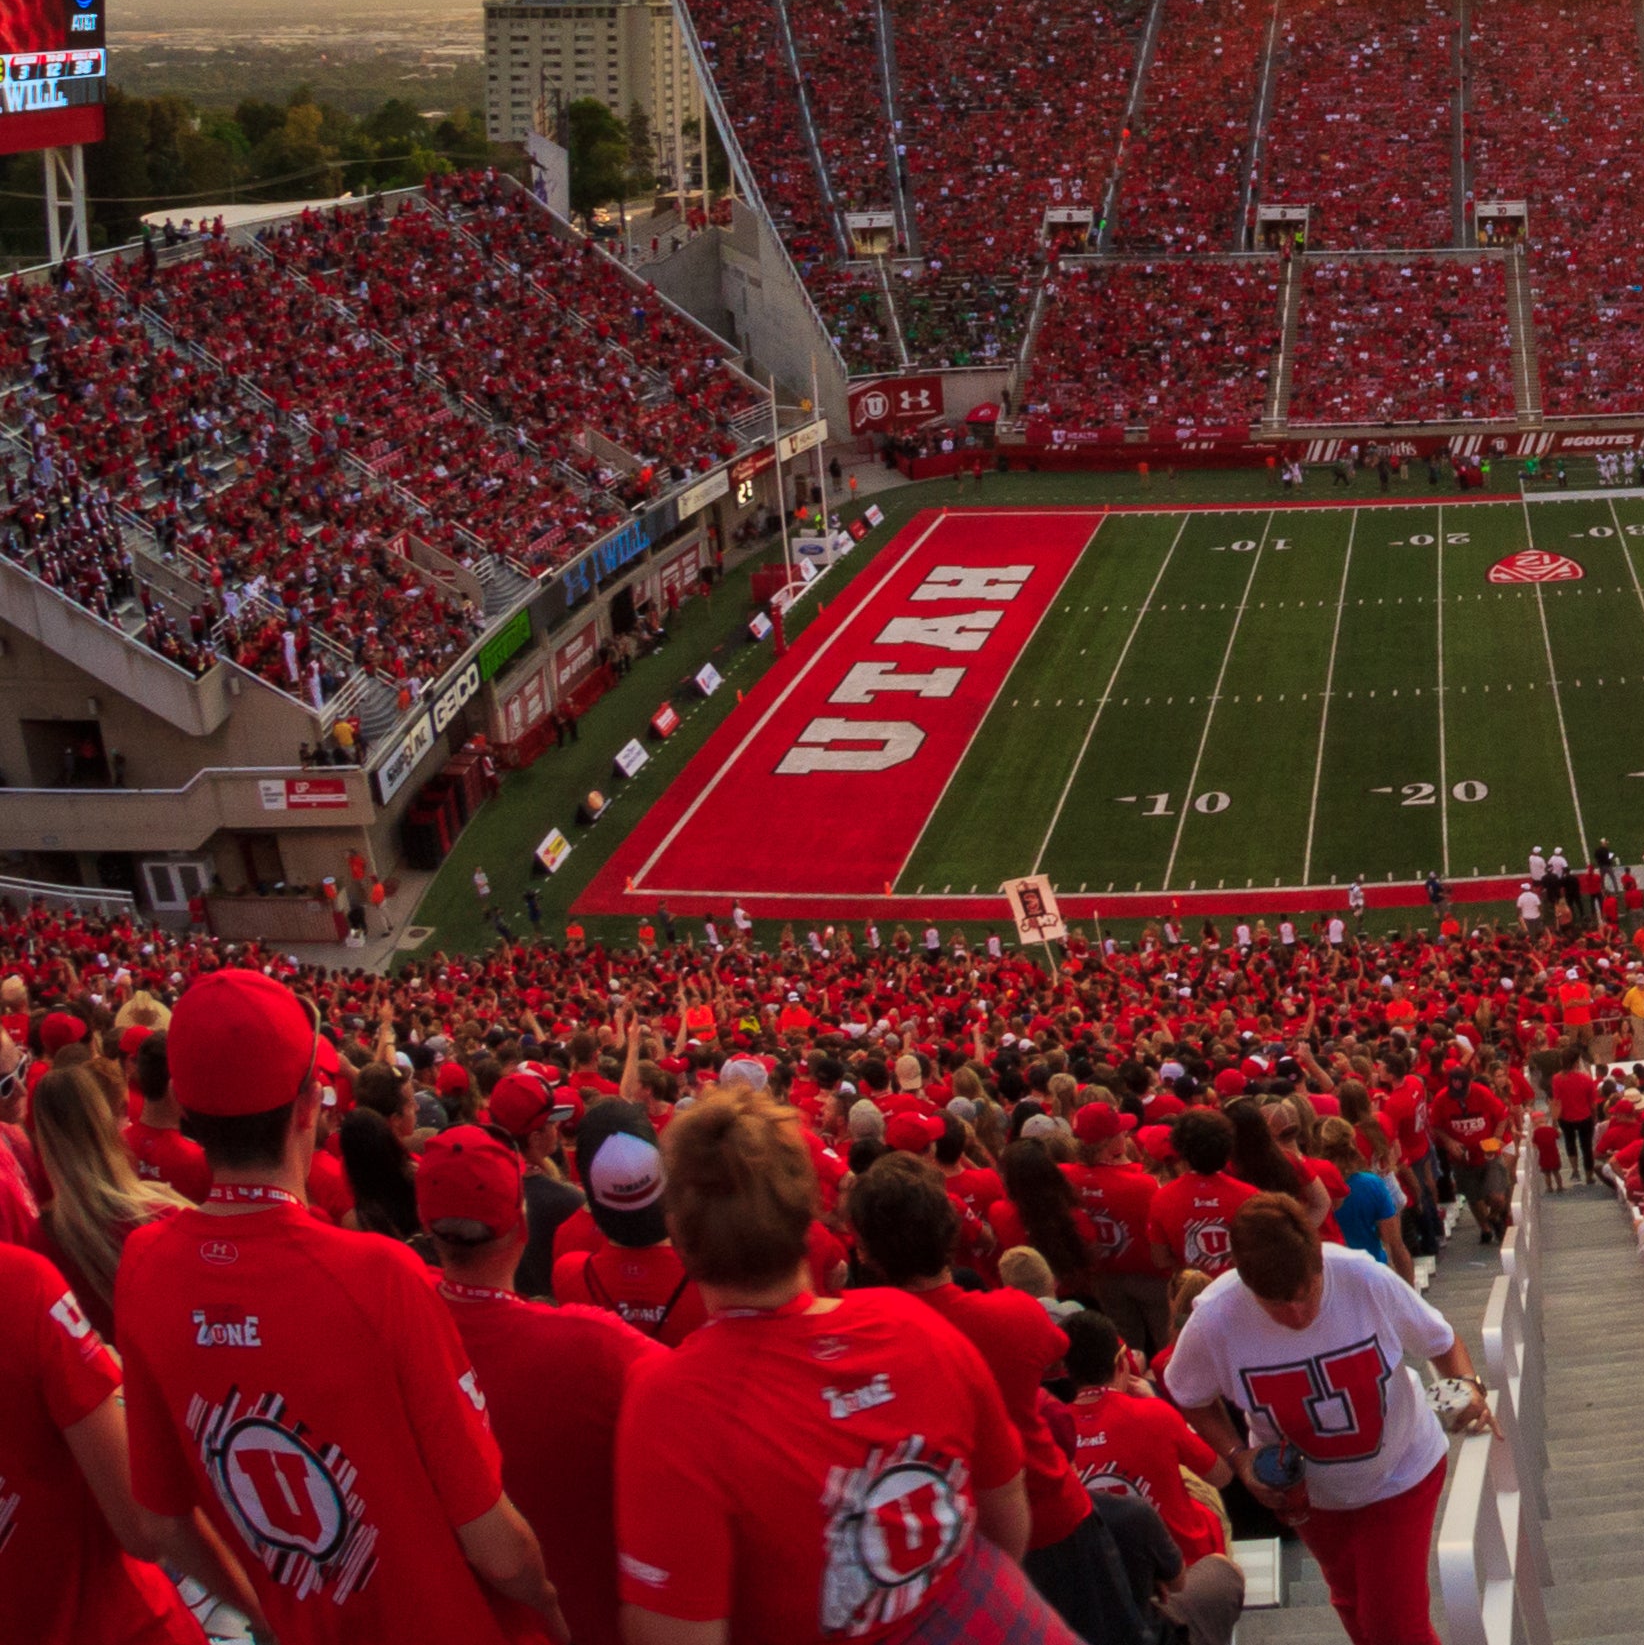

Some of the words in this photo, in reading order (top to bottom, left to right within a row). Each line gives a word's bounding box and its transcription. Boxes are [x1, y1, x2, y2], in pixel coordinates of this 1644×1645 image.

[1562, 434, 1636, 447] #GOUTES
[602, 520, 652, 576] WILL
[773, 564, 1036, 774] UTAH
[434, 661, 480, 734] GEICO
[1142, 791, 1231, 816] 10
[1401, 780, 1489, 806] 20
[1199, 1231, 1228, 1256] U
[50, 1291, 92, 1339] U
[192, 1309, 262, 1347] ZONE
[1240, 1335, 1393, 1463] U
[234, 1448, 327, 1554] U
[876, 1483, 943, 1576] U
